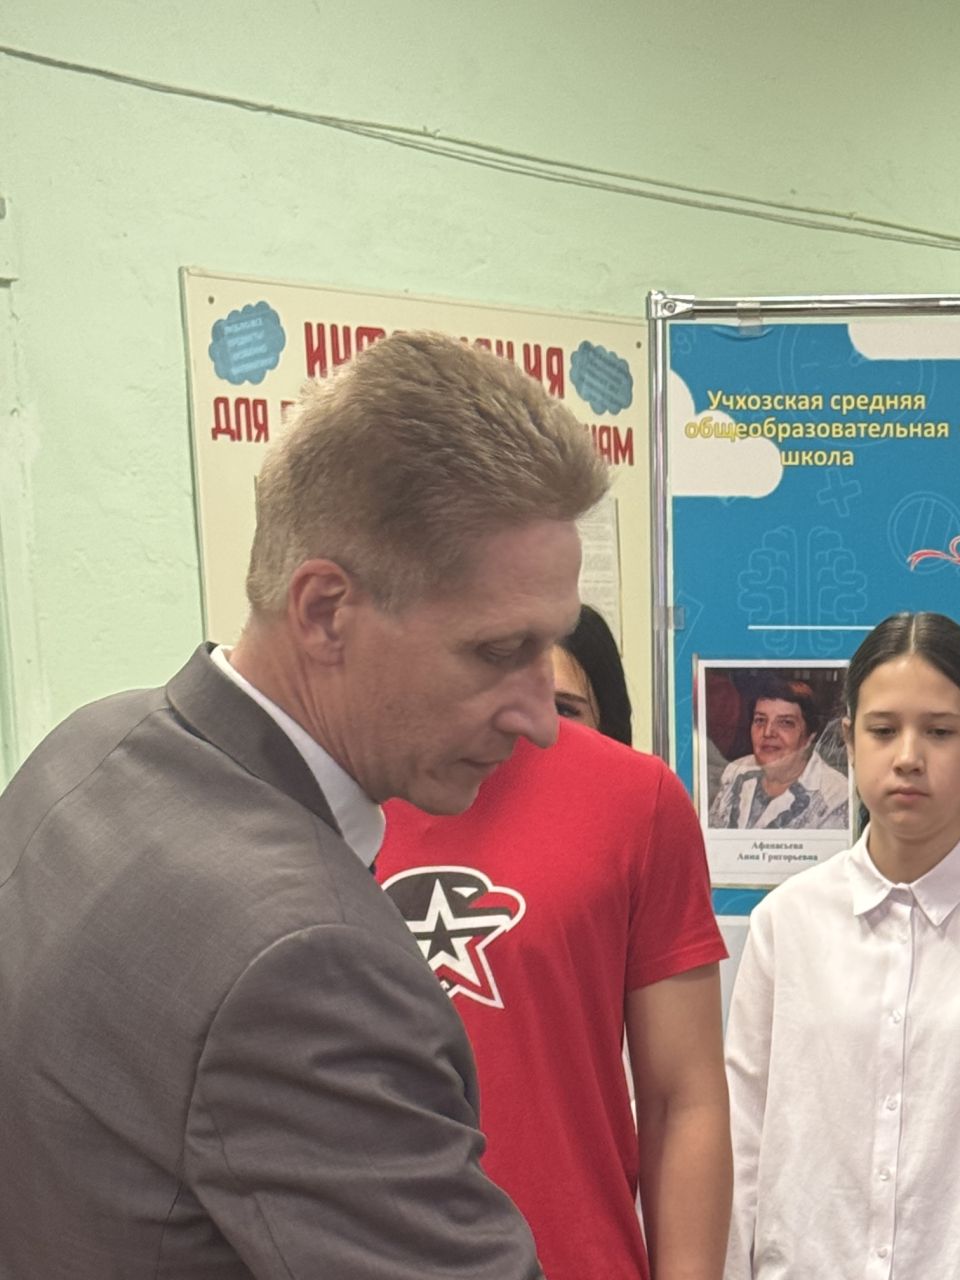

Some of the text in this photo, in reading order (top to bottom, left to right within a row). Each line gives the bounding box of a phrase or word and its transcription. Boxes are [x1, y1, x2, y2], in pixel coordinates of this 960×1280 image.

[706, 389, 927, 415] Учхозская средняя
[211, 396, 270, 443] ДЛЯ
[684, 416, 950, 442] общеобразовательная
[780, 449, 854, 467] школа
[751, 841, 804, 851] Афанасьева
[737, 853, 818, 863] Анна Григорьевна
